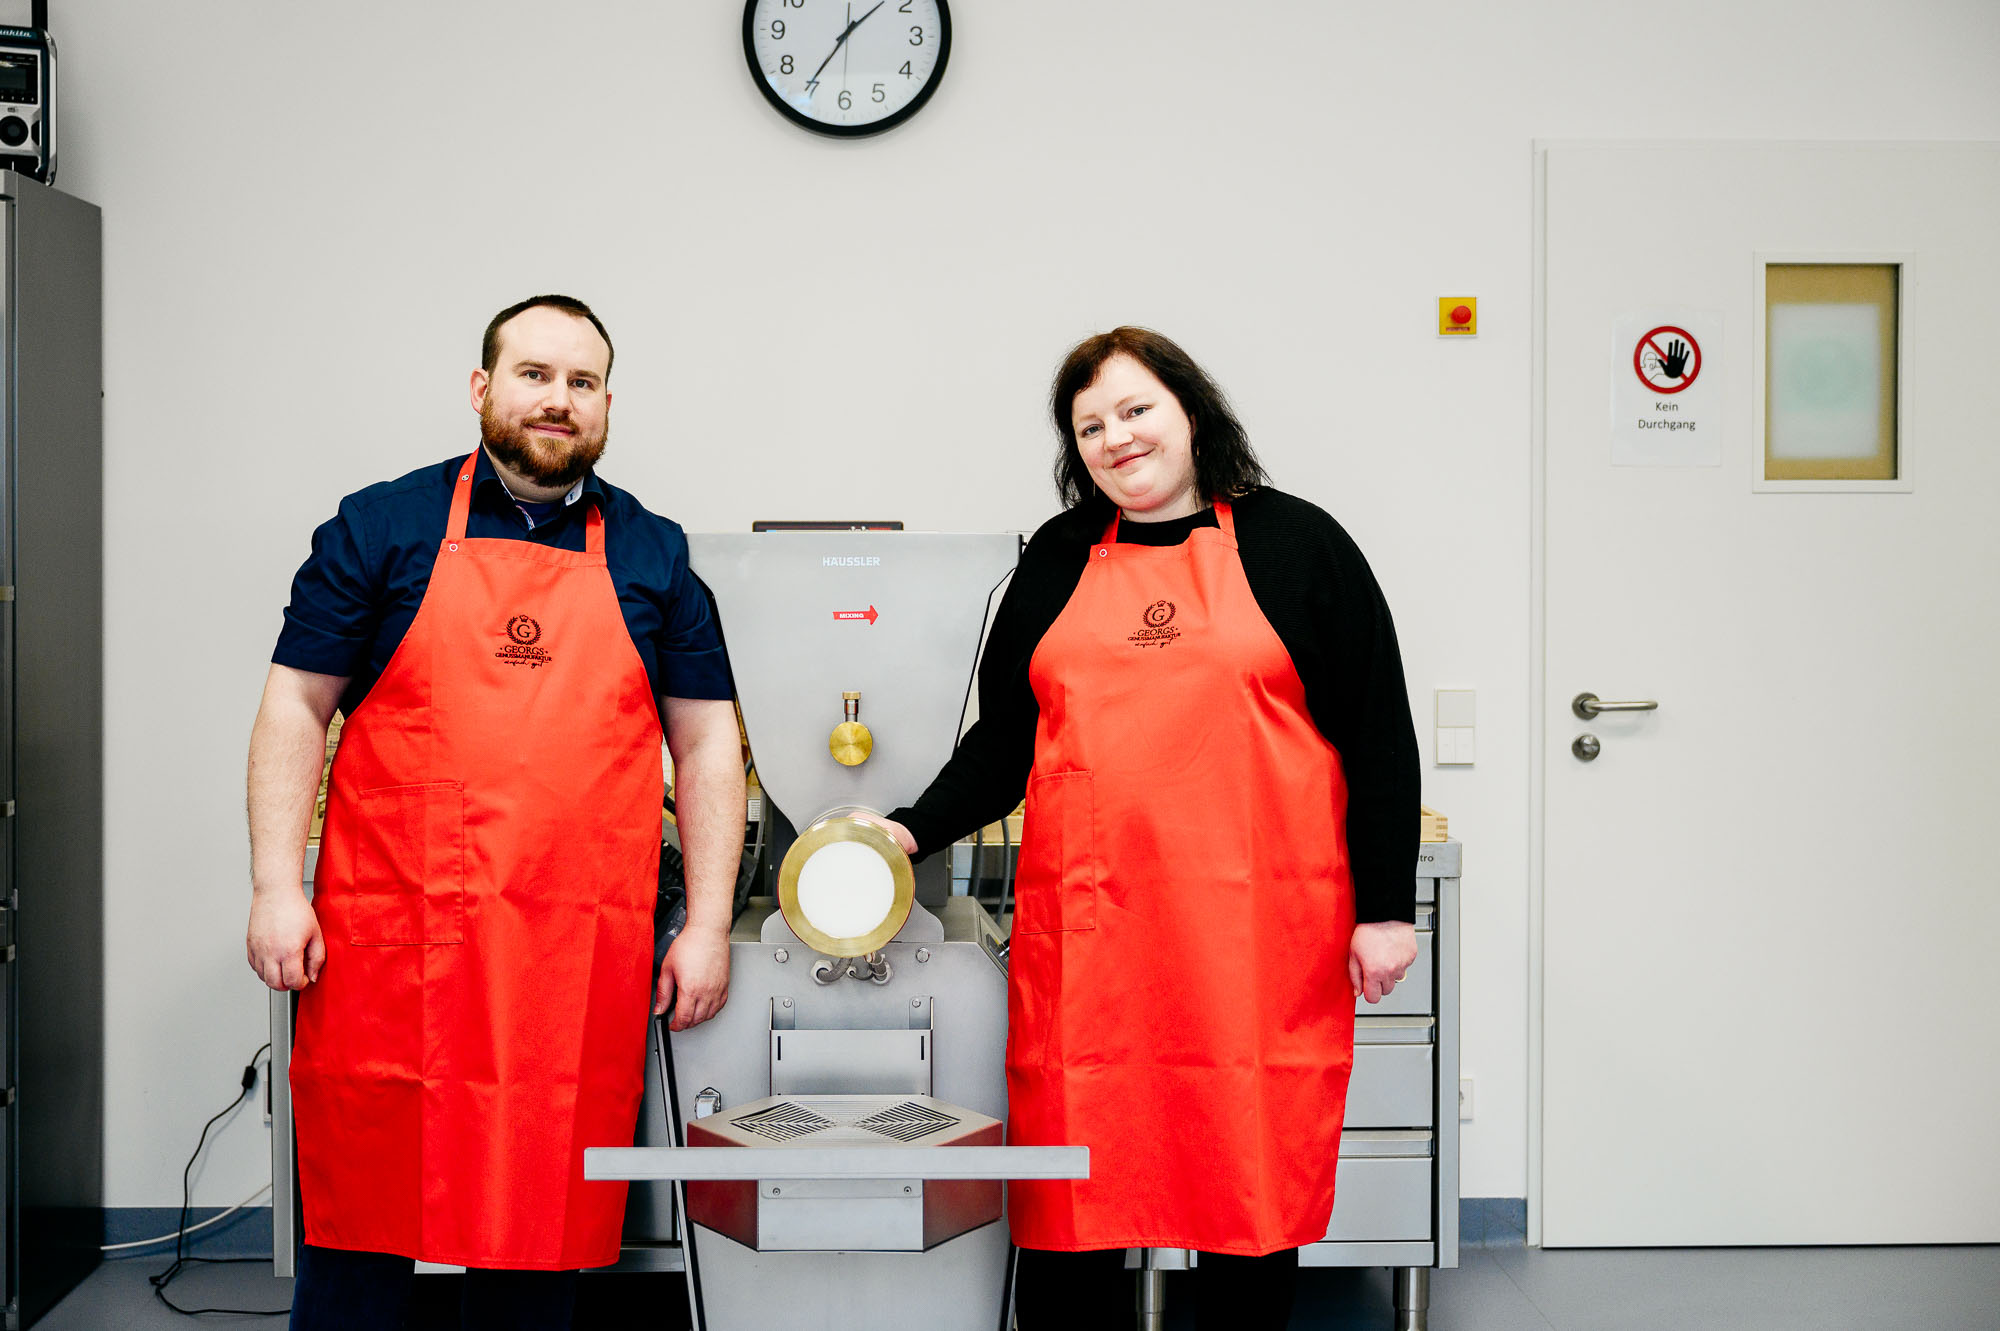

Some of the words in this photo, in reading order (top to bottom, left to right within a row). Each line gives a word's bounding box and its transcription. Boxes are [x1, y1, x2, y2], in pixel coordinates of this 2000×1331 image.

[771, 20, 786, 39] 9
[908, 26, 923, 46] 3
[780, 55, 794, 75] 8
[898, 60, 913, 79] 4
[838, 90, 852, 110] 6
[871, 83, 885, 103] 5
[1655, 402, 1679, 412] Kein
[1638, 419, 1696, 432] Durchgang
[1152, 608, 1165, 621] G
[517, 624, 531, 638] G
